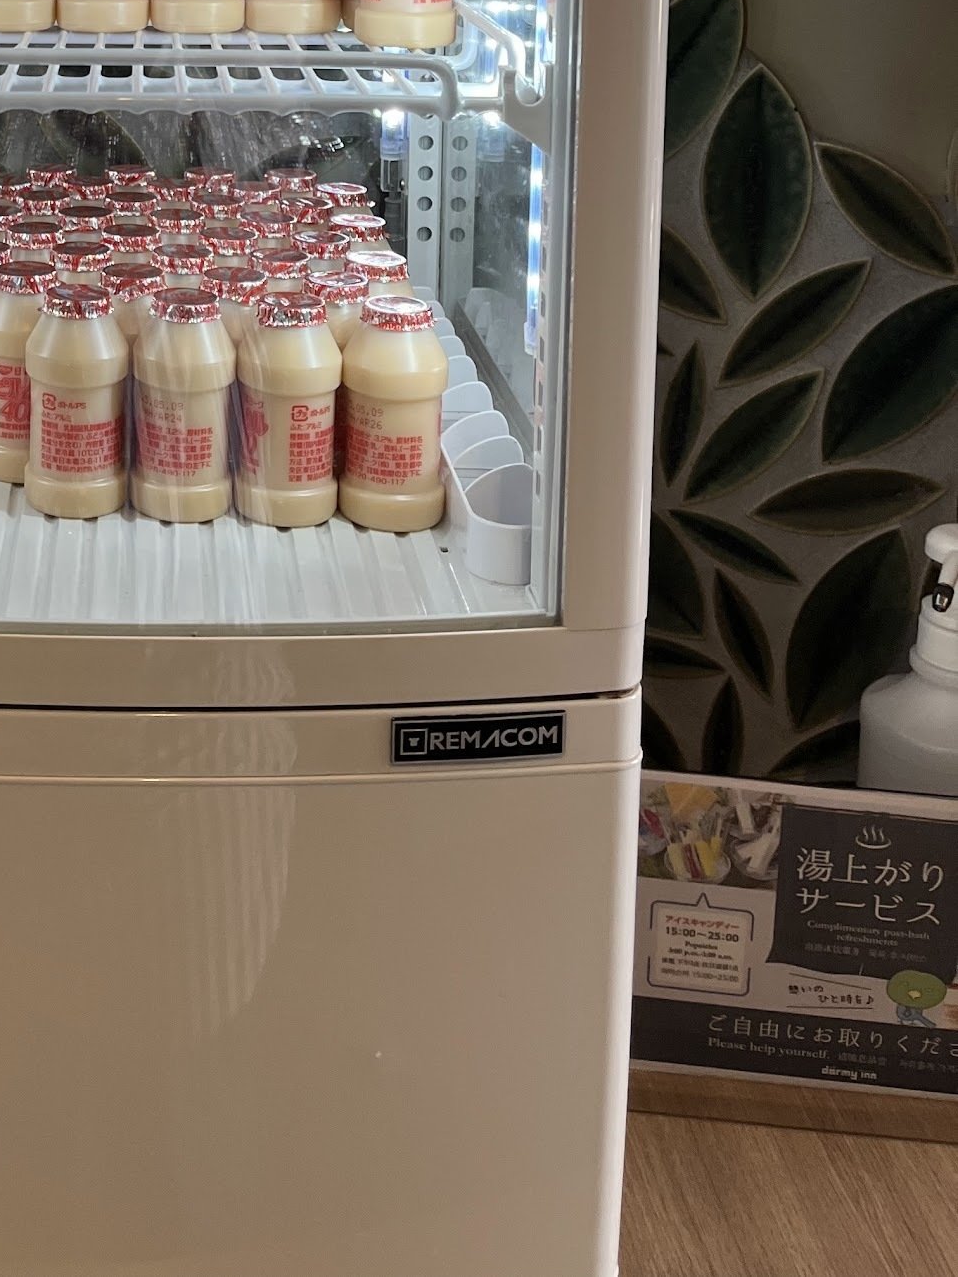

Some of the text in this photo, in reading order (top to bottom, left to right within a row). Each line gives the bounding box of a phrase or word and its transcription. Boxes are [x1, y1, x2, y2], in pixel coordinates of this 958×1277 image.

[430, 725, 558, 751] REMACOM
[796, 847, 944, 892] 湯上がり
[796, 888, 940, 925] サービス
[665, 915, 740, 929] アイスキャンディー
[666, 926, 739, 942] 15:00～25:00
[708, 1036, 746, 1052] Please
[750, 1042, 775, 1056] help
[779, 1048, 830, 1060] yourself.
[822, 1065, 878, 1081] dormy inn
